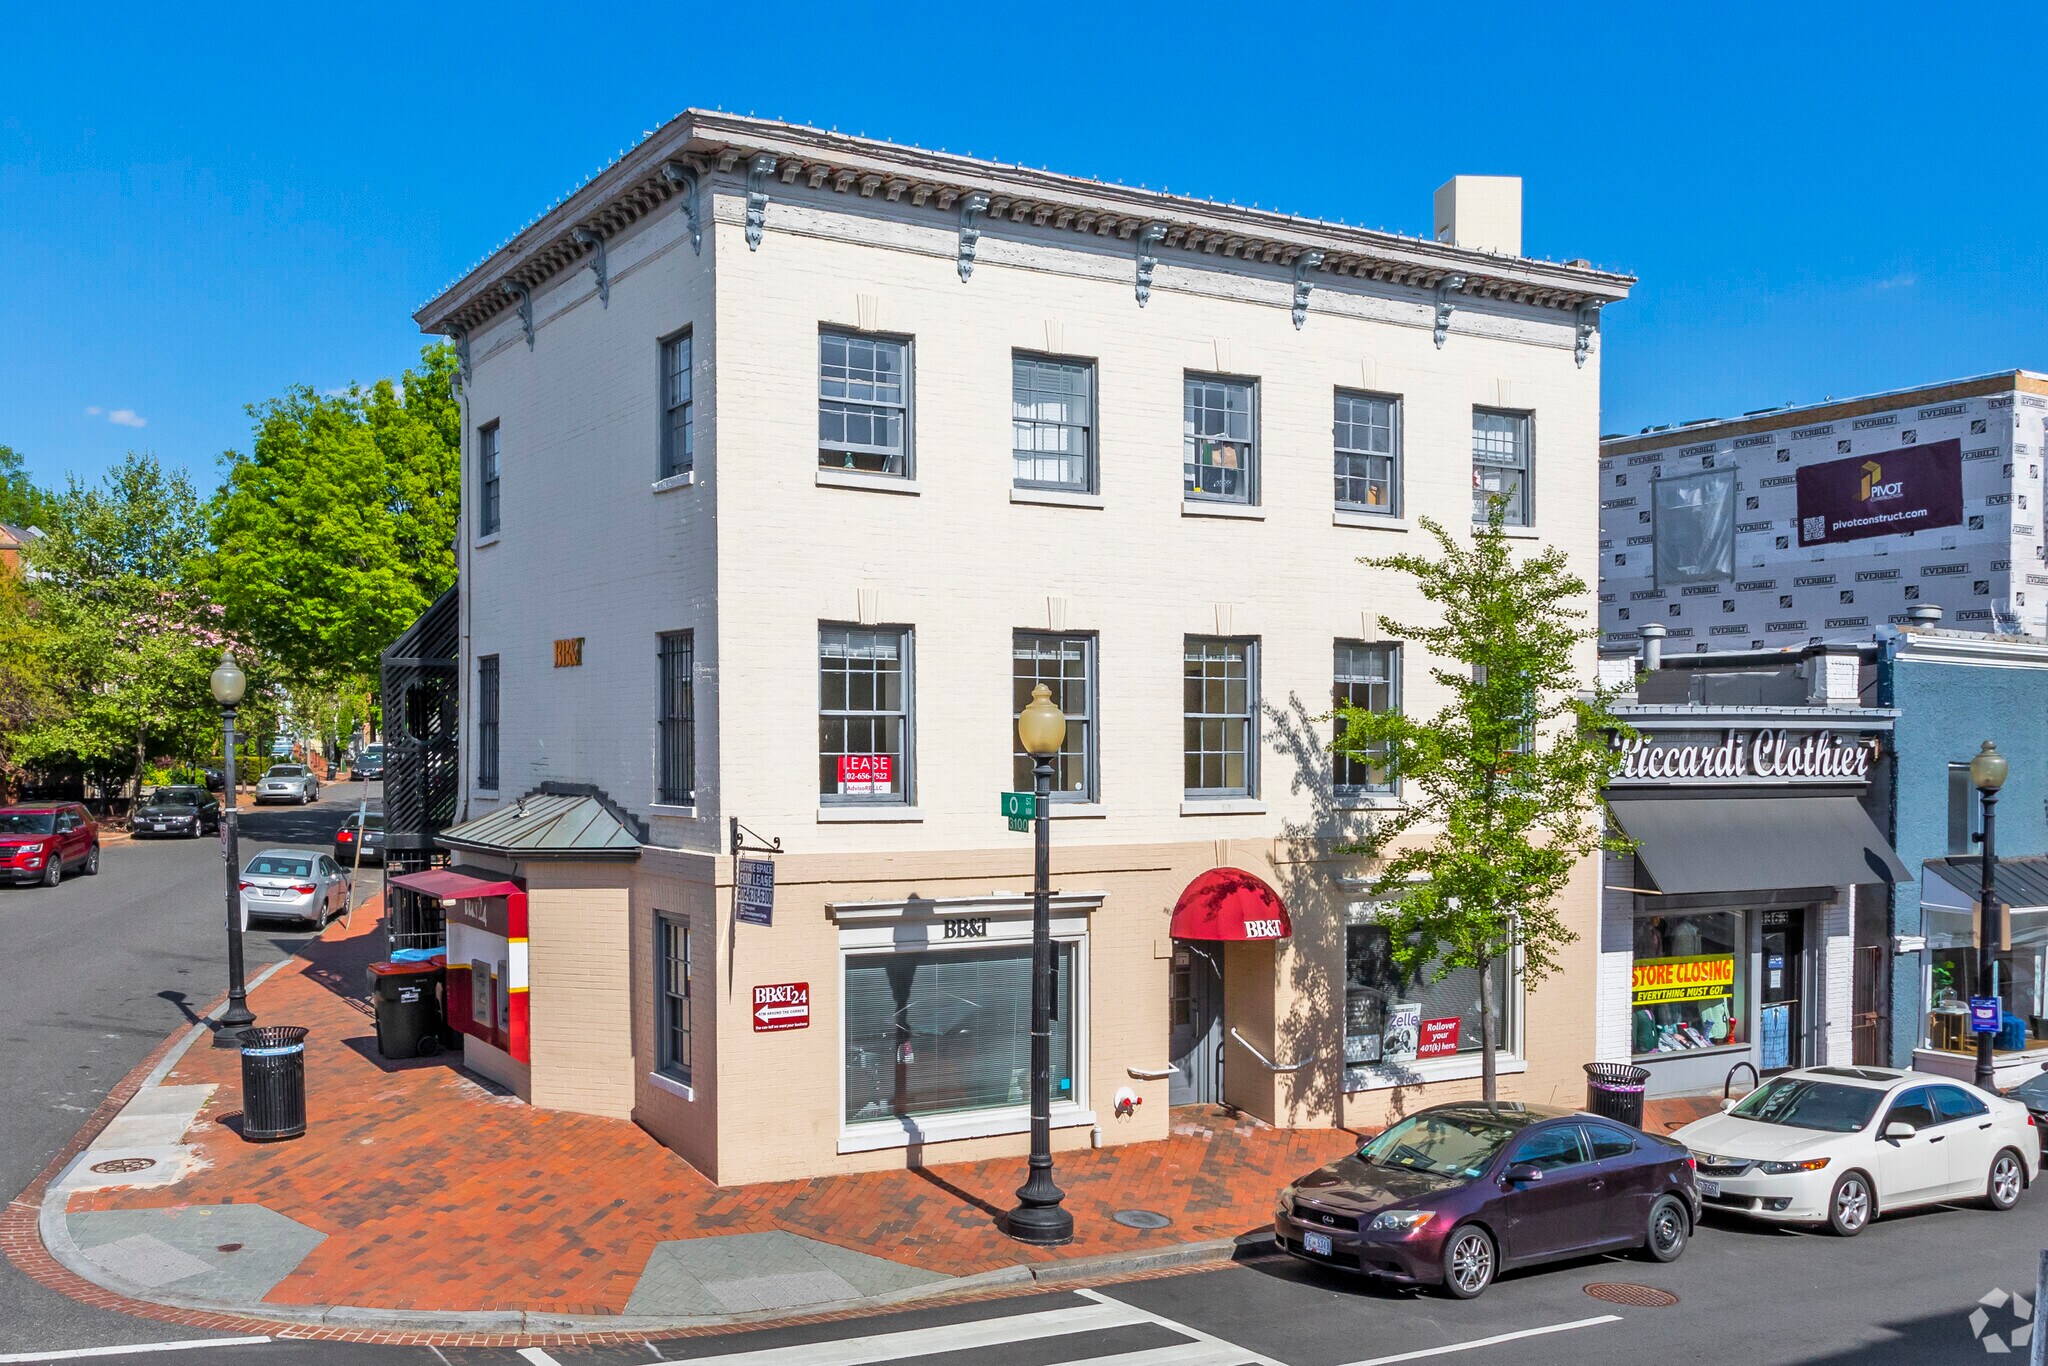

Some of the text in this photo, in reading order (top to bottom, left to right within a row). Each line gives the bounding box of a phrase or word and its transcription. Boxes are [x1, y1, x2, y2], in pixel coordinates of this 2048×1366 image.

[1920, 405, 1964, 419] EVERBILT
[1855, 415, 1895, 429] EVERBILT
[1793, 427, 1831, 439] EVERBILT
[1735, 436, 1771, 448] EVERBILT
[1681, 445, 1714, 457] EVERBILT
[1629, 455, 1662, 466] EVERBILT
[1871, 482, 1903, 497] PIVOT
[1833, 509, 1928, 531] pivotconstruct.com
[1857, 570, 1898, 581] EVERBILT
[1923, 565, 1966, 576] EVERBILT
[1738, 581, 1774, 591] EVERBILT
[1795, 575, 1834, 586] EVERBILT
[1683, 586, 1717, 596] EVERBILT
[1767, 622, 1805, 632] EVERBILT
[1827, 617, 1867, 628] EVERBILT
[1711, 625, 1747, 635] EVERBILT
[553, 637, 585, 668] BB&T
[1609, 727, 1869, 778] Riccardi Clothier
[843, 772, 888, 780] 02-656-7522
[1010, 796, 1032, 815] O ST
[1009, 817, 1028, 831] 3100
[740, 862, 772, 875] OFFICE SPACE
[740, 872, 772, 887] FOR LEASE
[943, 917, 991, 939] BB&T
[1244, 919, 1282, 938] BB&T
[1632, 959, 1731, 987] STORE CLOSING
[1637, 986, 1724, 1001] EVERYTHING MUST GO!
[1389, 1012, 1419, 1028] Zelle
[1427, 1022, 1456, 1032] Rollover
[1431, 1031, 1449, 1042] your
[1420, 1042, 1456, 1053] 401(k) here.
